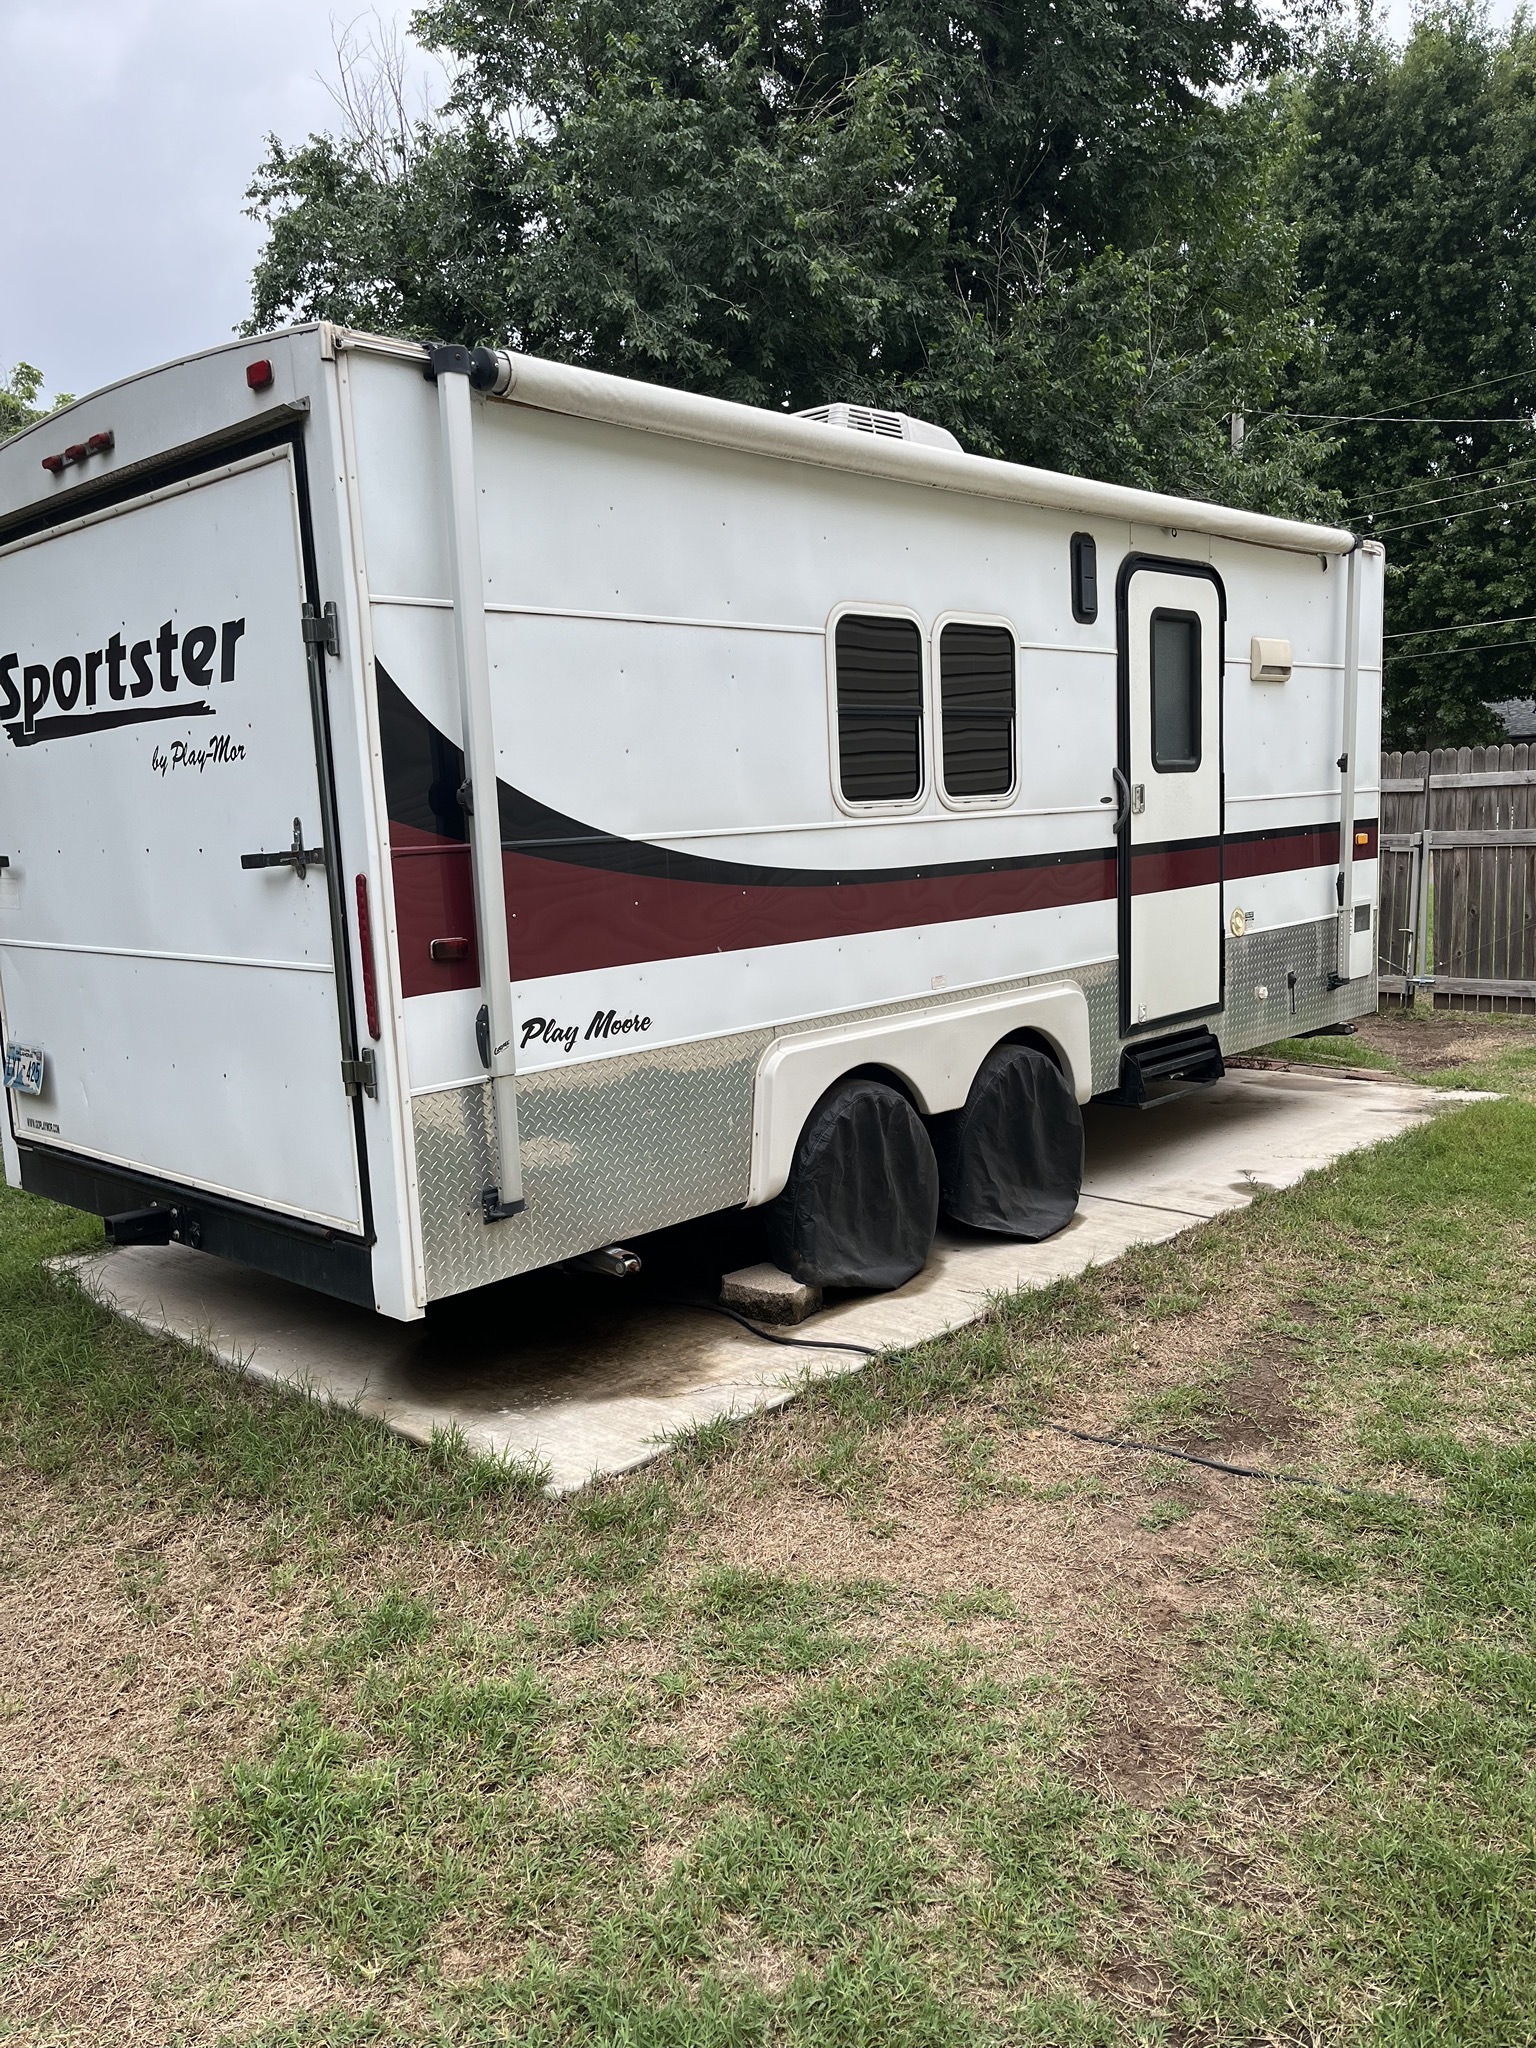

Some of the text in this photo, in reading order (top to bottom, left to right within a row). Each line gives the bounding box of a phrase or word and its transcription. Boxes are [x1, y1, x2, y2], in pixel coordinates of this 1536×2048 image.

[0, 617, 246, 734] Sportster
[152, 735, 247, 777] by Play-Mor
[519, 1017, 580, 1053] Play
[583, 1009, 653, 1041] Moore
